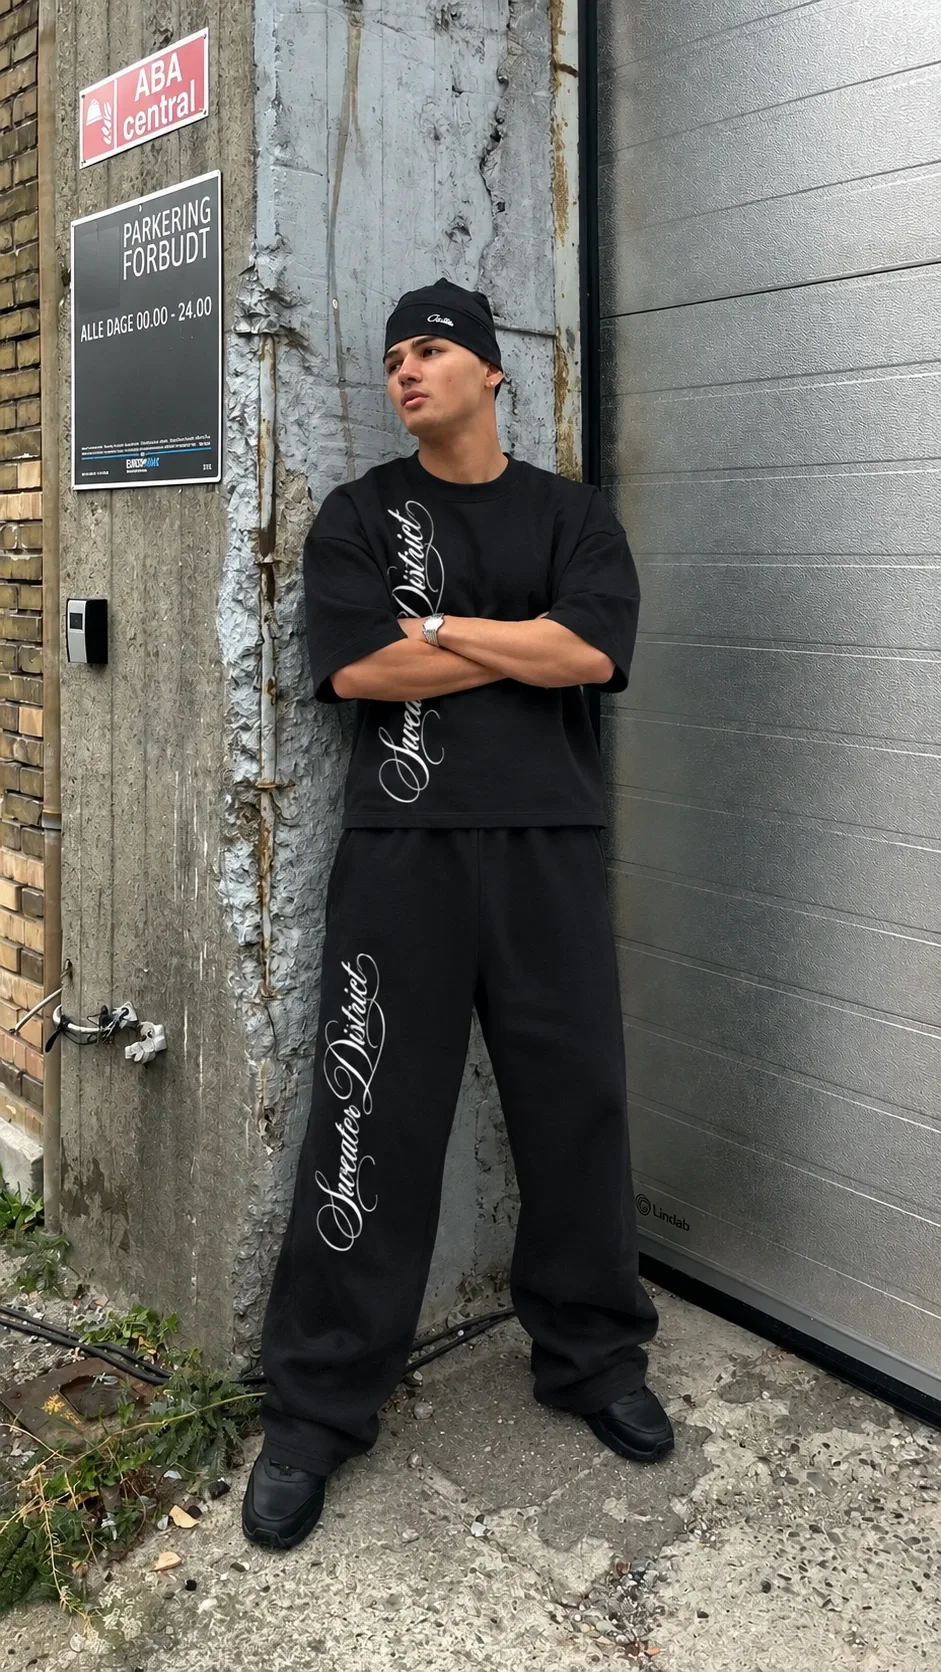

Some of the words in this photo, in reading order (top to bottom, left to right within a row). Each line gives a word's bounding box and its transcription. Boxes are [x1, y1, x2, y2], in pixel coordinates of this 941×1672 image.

[134, 51, 183, 102] ABA
[123, 79, 196, 140] central
[123, 196, 211, 248] PARKERING
[123, 227, 211, 280] FORBUDT
[80, 321, 104, 342] ALLE
[106, 314, 134, 337] DAGE
[136, 306, 168, 330] 00.00
[178, 296, 212, 321] 24.00
[387, 500, 445, 618] District
[323, 953, 386, 1115] District
[315, 1104, 378, 1252] Sweater
[652, 1204, 690, 1231] Lindab
